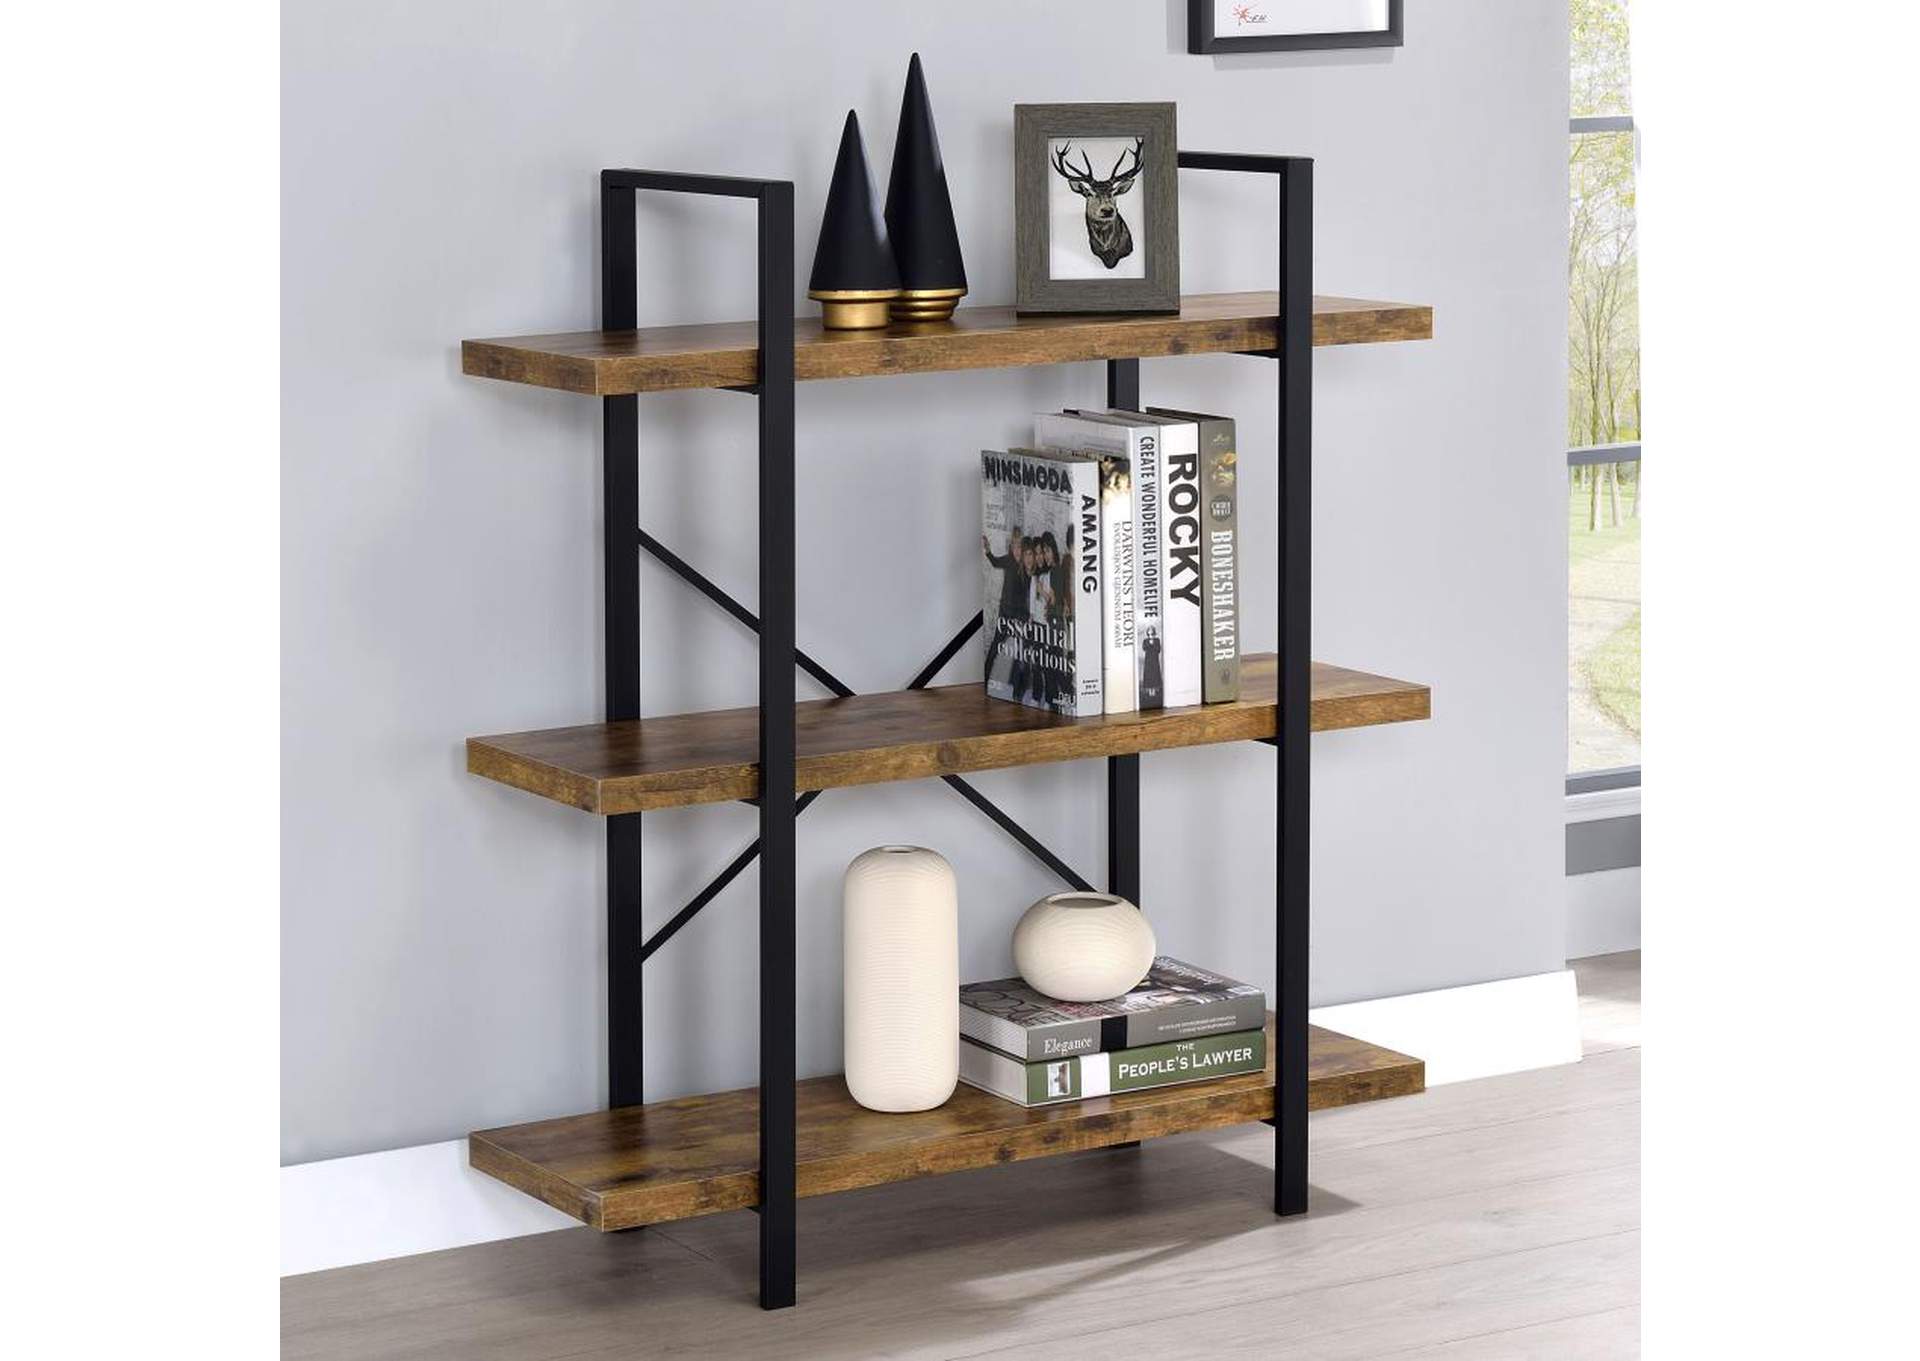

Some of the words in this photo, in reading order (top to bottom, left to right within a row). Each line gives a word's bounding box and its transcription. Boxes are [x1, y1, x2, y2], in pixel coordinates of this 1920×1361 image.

[1140, 436, 1155, 478] CREATE
[1141, 482, 1157, 556] WONDERFUL
[1168, 453, 1200, 607] ROCKY
[1082, 494, 1098, 593] AMANG
[1122, 520, 1134, 595] DARWINS
[1143, 560, 1159, 618] HOMELIFE
[1211, 530, 1235, 661] BONESHAKER
[997, 616, 1075, 651] essential
[1123, 602, 1134, 647] TEORI
[997, 637, 1076, 673] collections
[1044, 1038, 1092, 1056] Elegance
[1118, 1057, 1188, 1079] PEOPLE'S
[1192, 1047, 1252, 1068] LAWYER
[1176, 1043, 1194, 1051] THE
